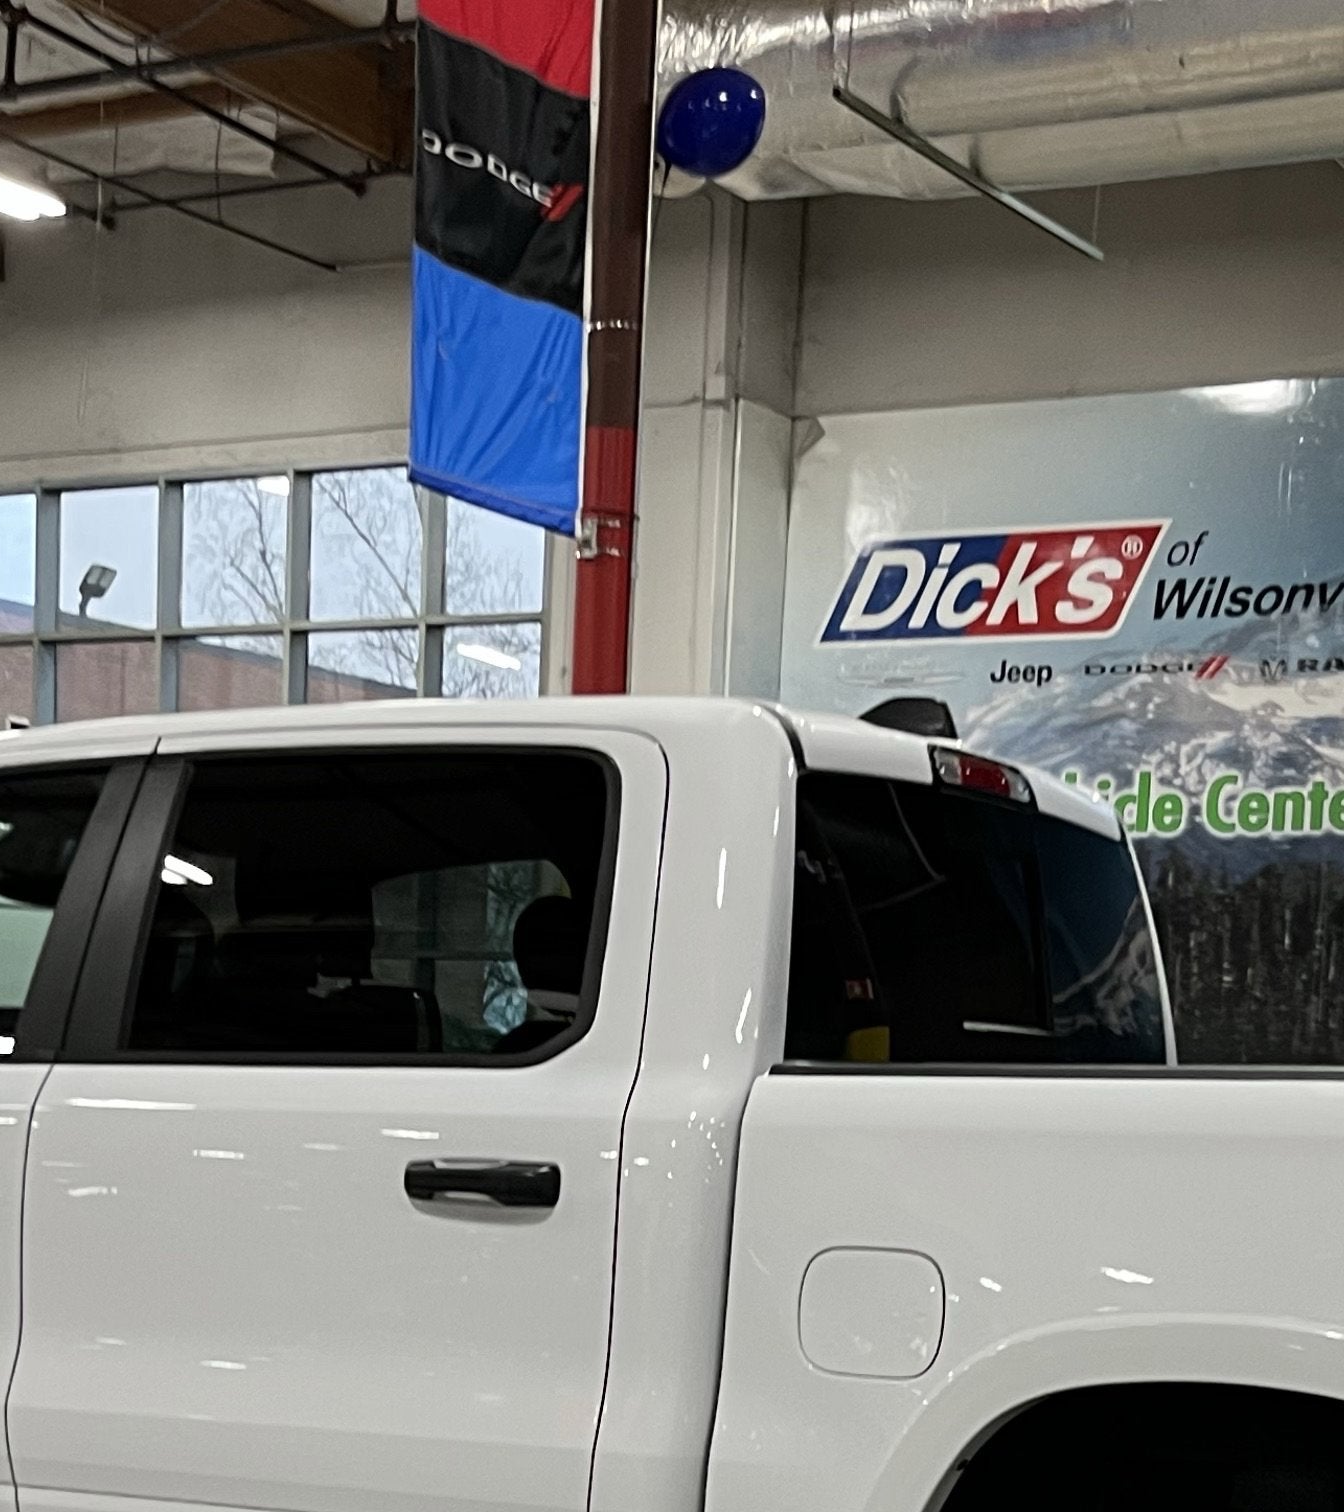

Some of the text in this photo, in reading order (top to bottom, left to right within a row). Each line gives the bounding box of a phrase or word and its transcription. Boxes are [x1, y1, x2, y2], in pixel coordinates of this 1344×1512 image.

[421, 128, 553, 208] DODGE
[1166, 531, 1209, 567] of
[838, 535, 1124, 632] Dick's
[990, 660, 1053, 687] Jeep
